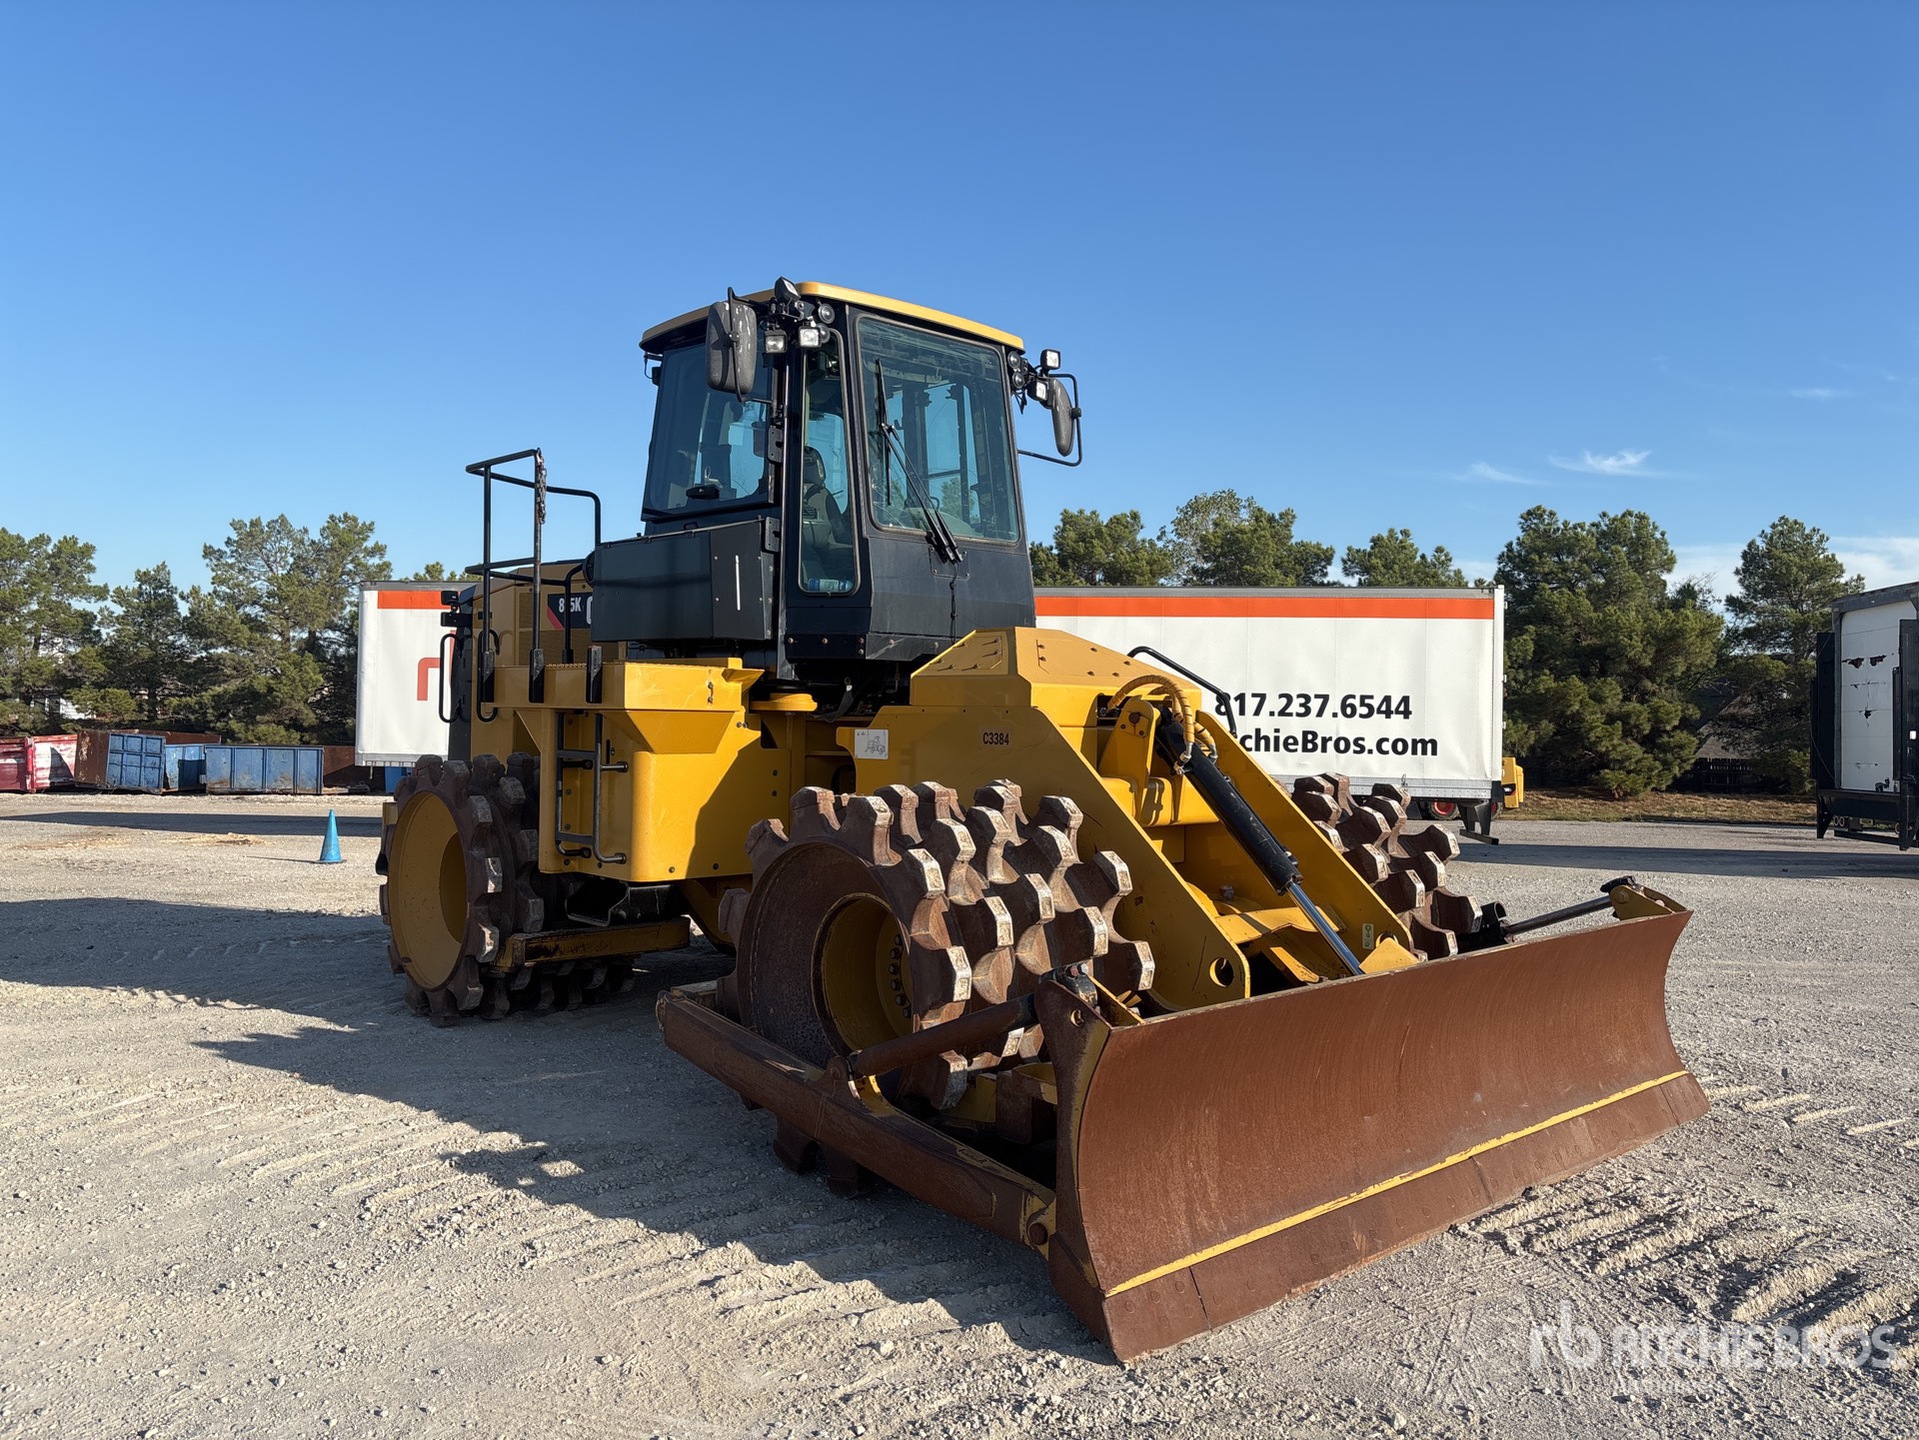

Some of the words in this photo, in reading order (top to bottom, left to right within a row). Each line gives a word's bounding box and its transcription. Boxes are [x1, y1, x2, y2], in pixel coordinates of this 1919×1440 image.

[558, 597, 581, 613] 85K
[982, 732, 1010, 745] C3384
[1239, 727, 1438, 756] chieBros.com
